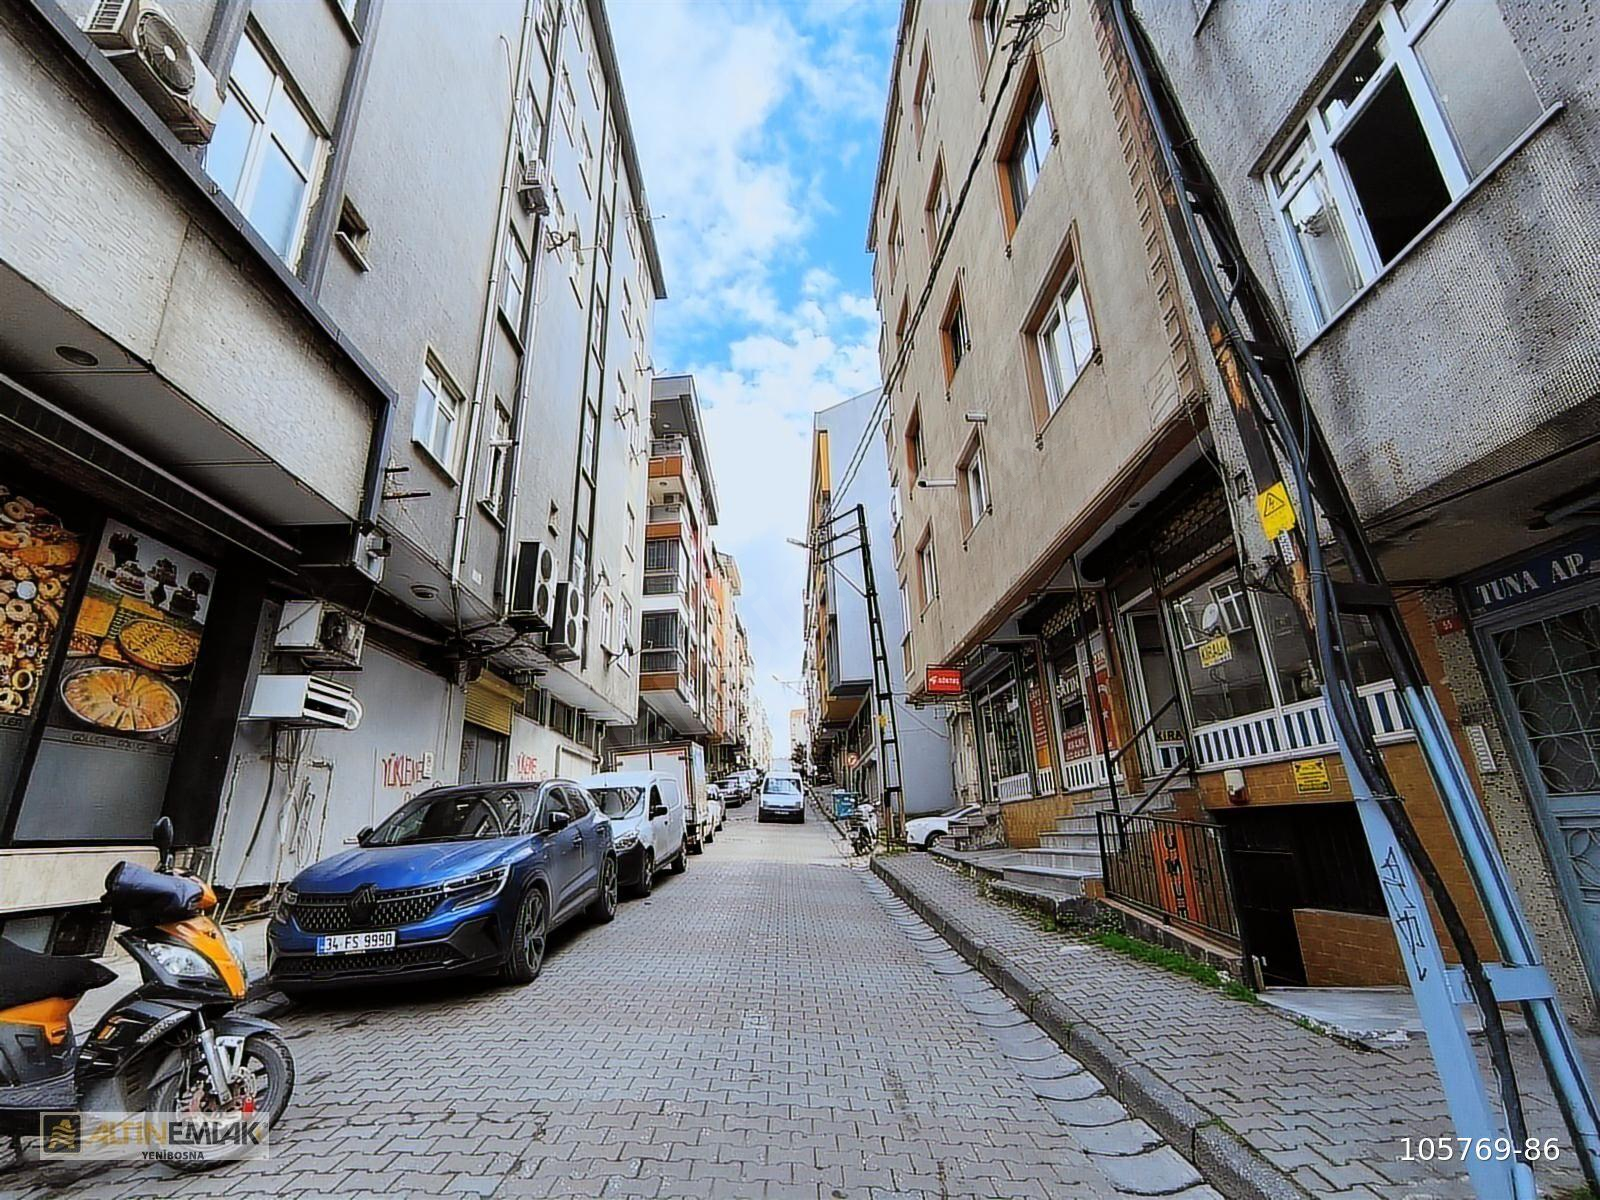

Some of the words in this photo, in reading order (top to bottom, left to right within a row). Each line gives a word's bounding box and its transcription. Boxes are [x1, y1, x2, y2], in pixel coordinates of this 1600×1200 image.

[1475, 570, 1541, 605] TUNA
[326, 937, 338, 951] 34
[345, 935, 359, 950] FS
[364, 932, 393, 948] 9990
